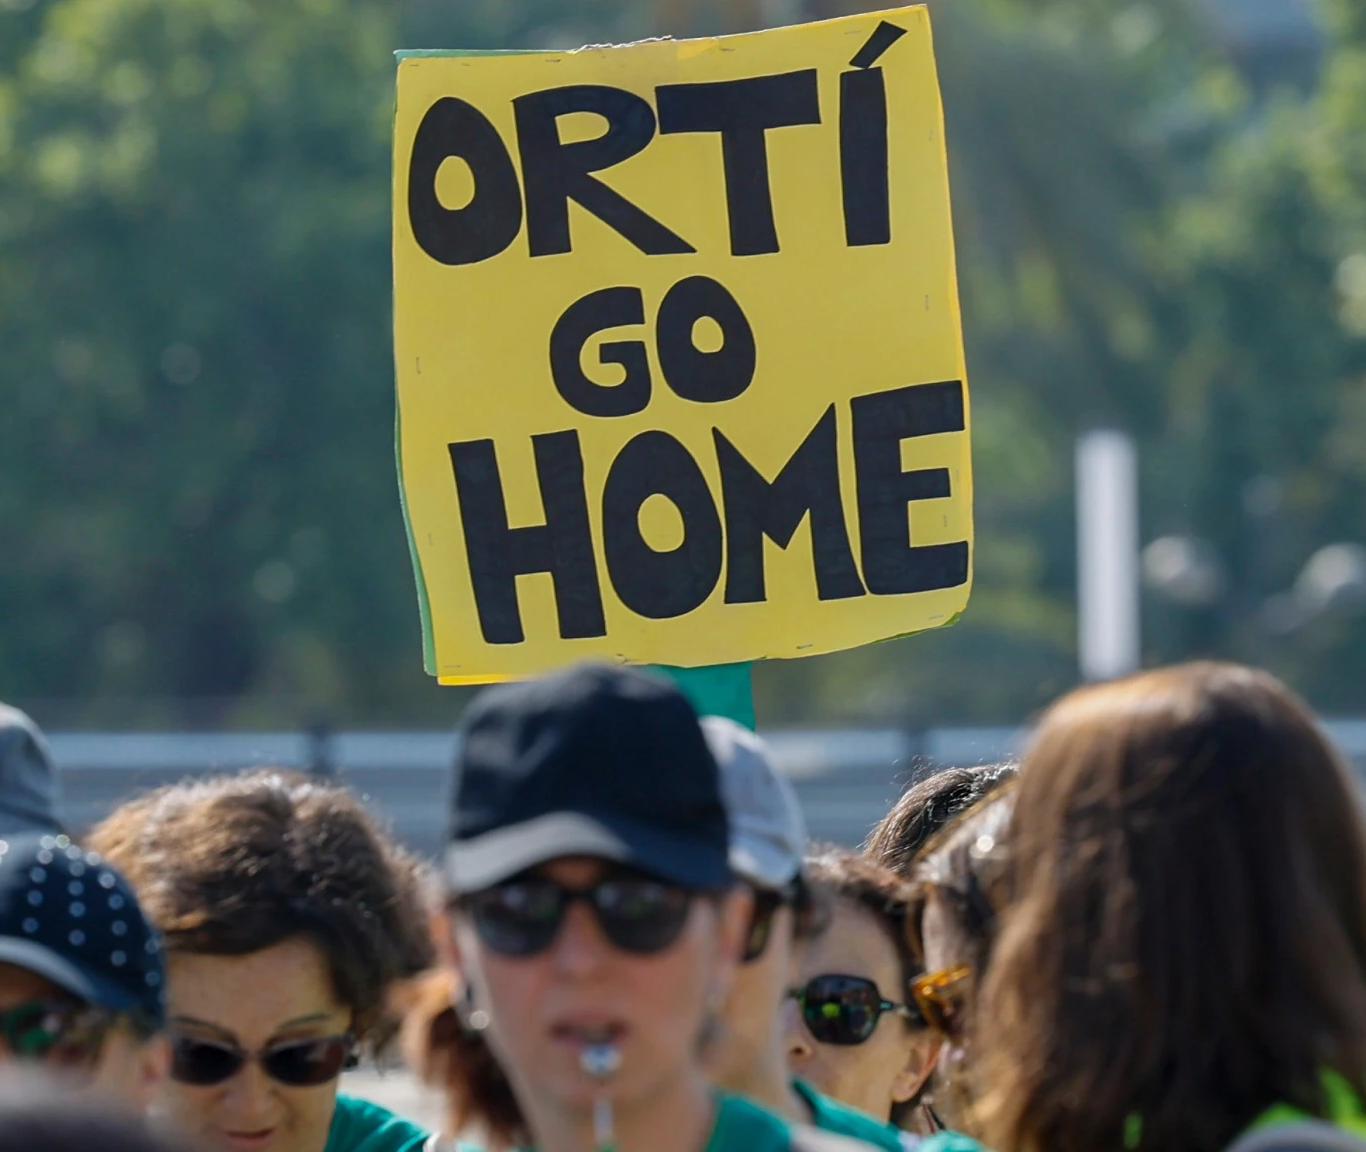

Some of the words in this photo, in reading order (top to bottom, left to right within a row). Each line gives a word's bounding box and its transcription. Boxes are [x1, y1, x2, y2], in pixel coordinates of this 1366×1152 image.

[408, 20, 907, 266] ORTÍ
[549, 275, 756, 418] GO
[448, 380, 968, 645] HOME
